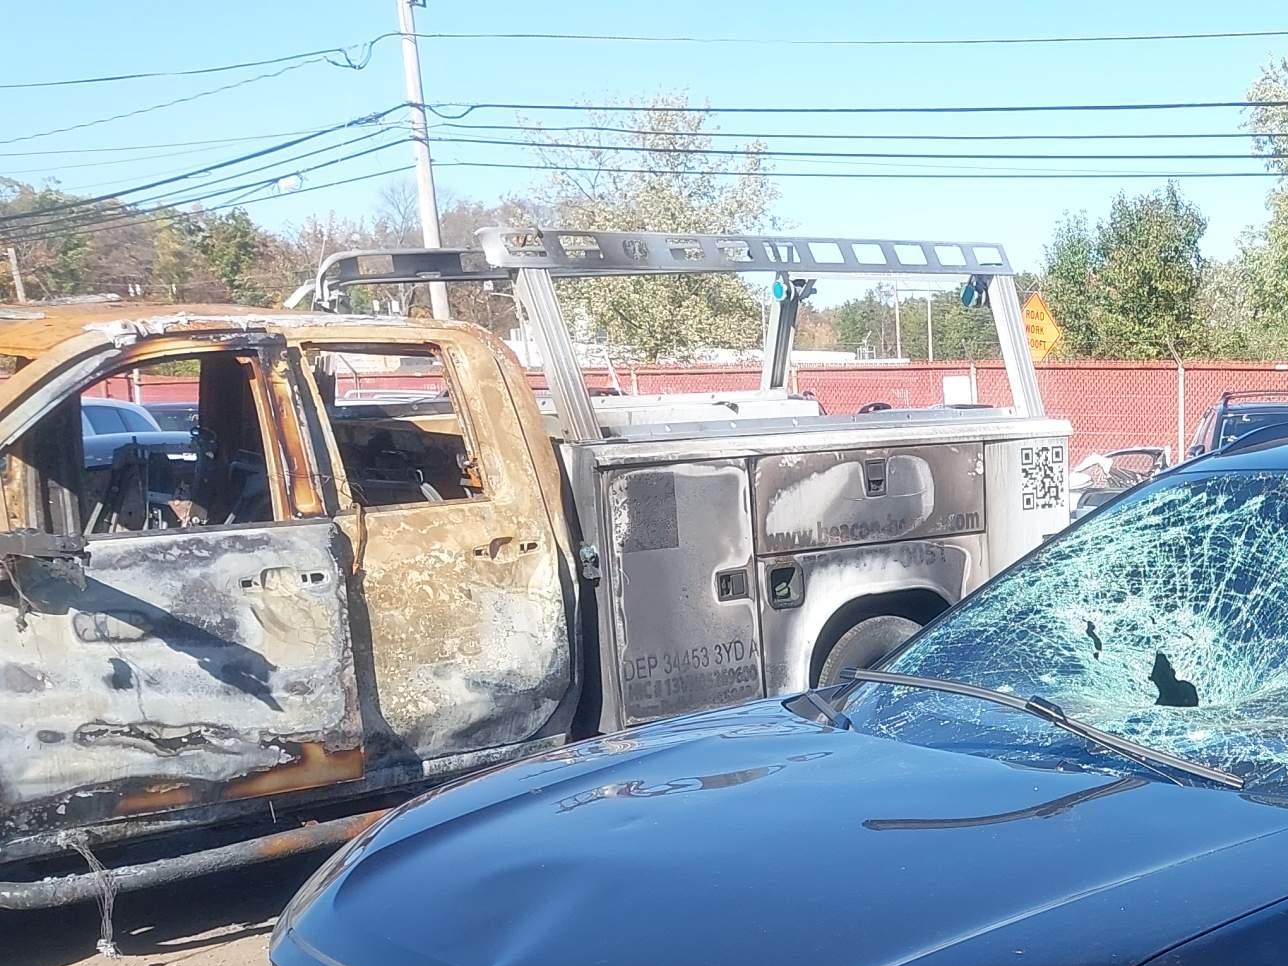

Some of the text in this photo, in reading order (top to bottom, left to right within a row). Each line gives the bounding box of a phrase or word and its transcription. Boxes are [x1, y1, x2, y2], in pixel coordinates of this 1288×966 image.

[1025, 309, 1045, 321] ROAD
[1025, 324, 1045, 335] WORK
[1027, 338, 1047, 350] 00FT
[623, 656, 658, 682] DEP
[663, 647, 710, 674] 34453
